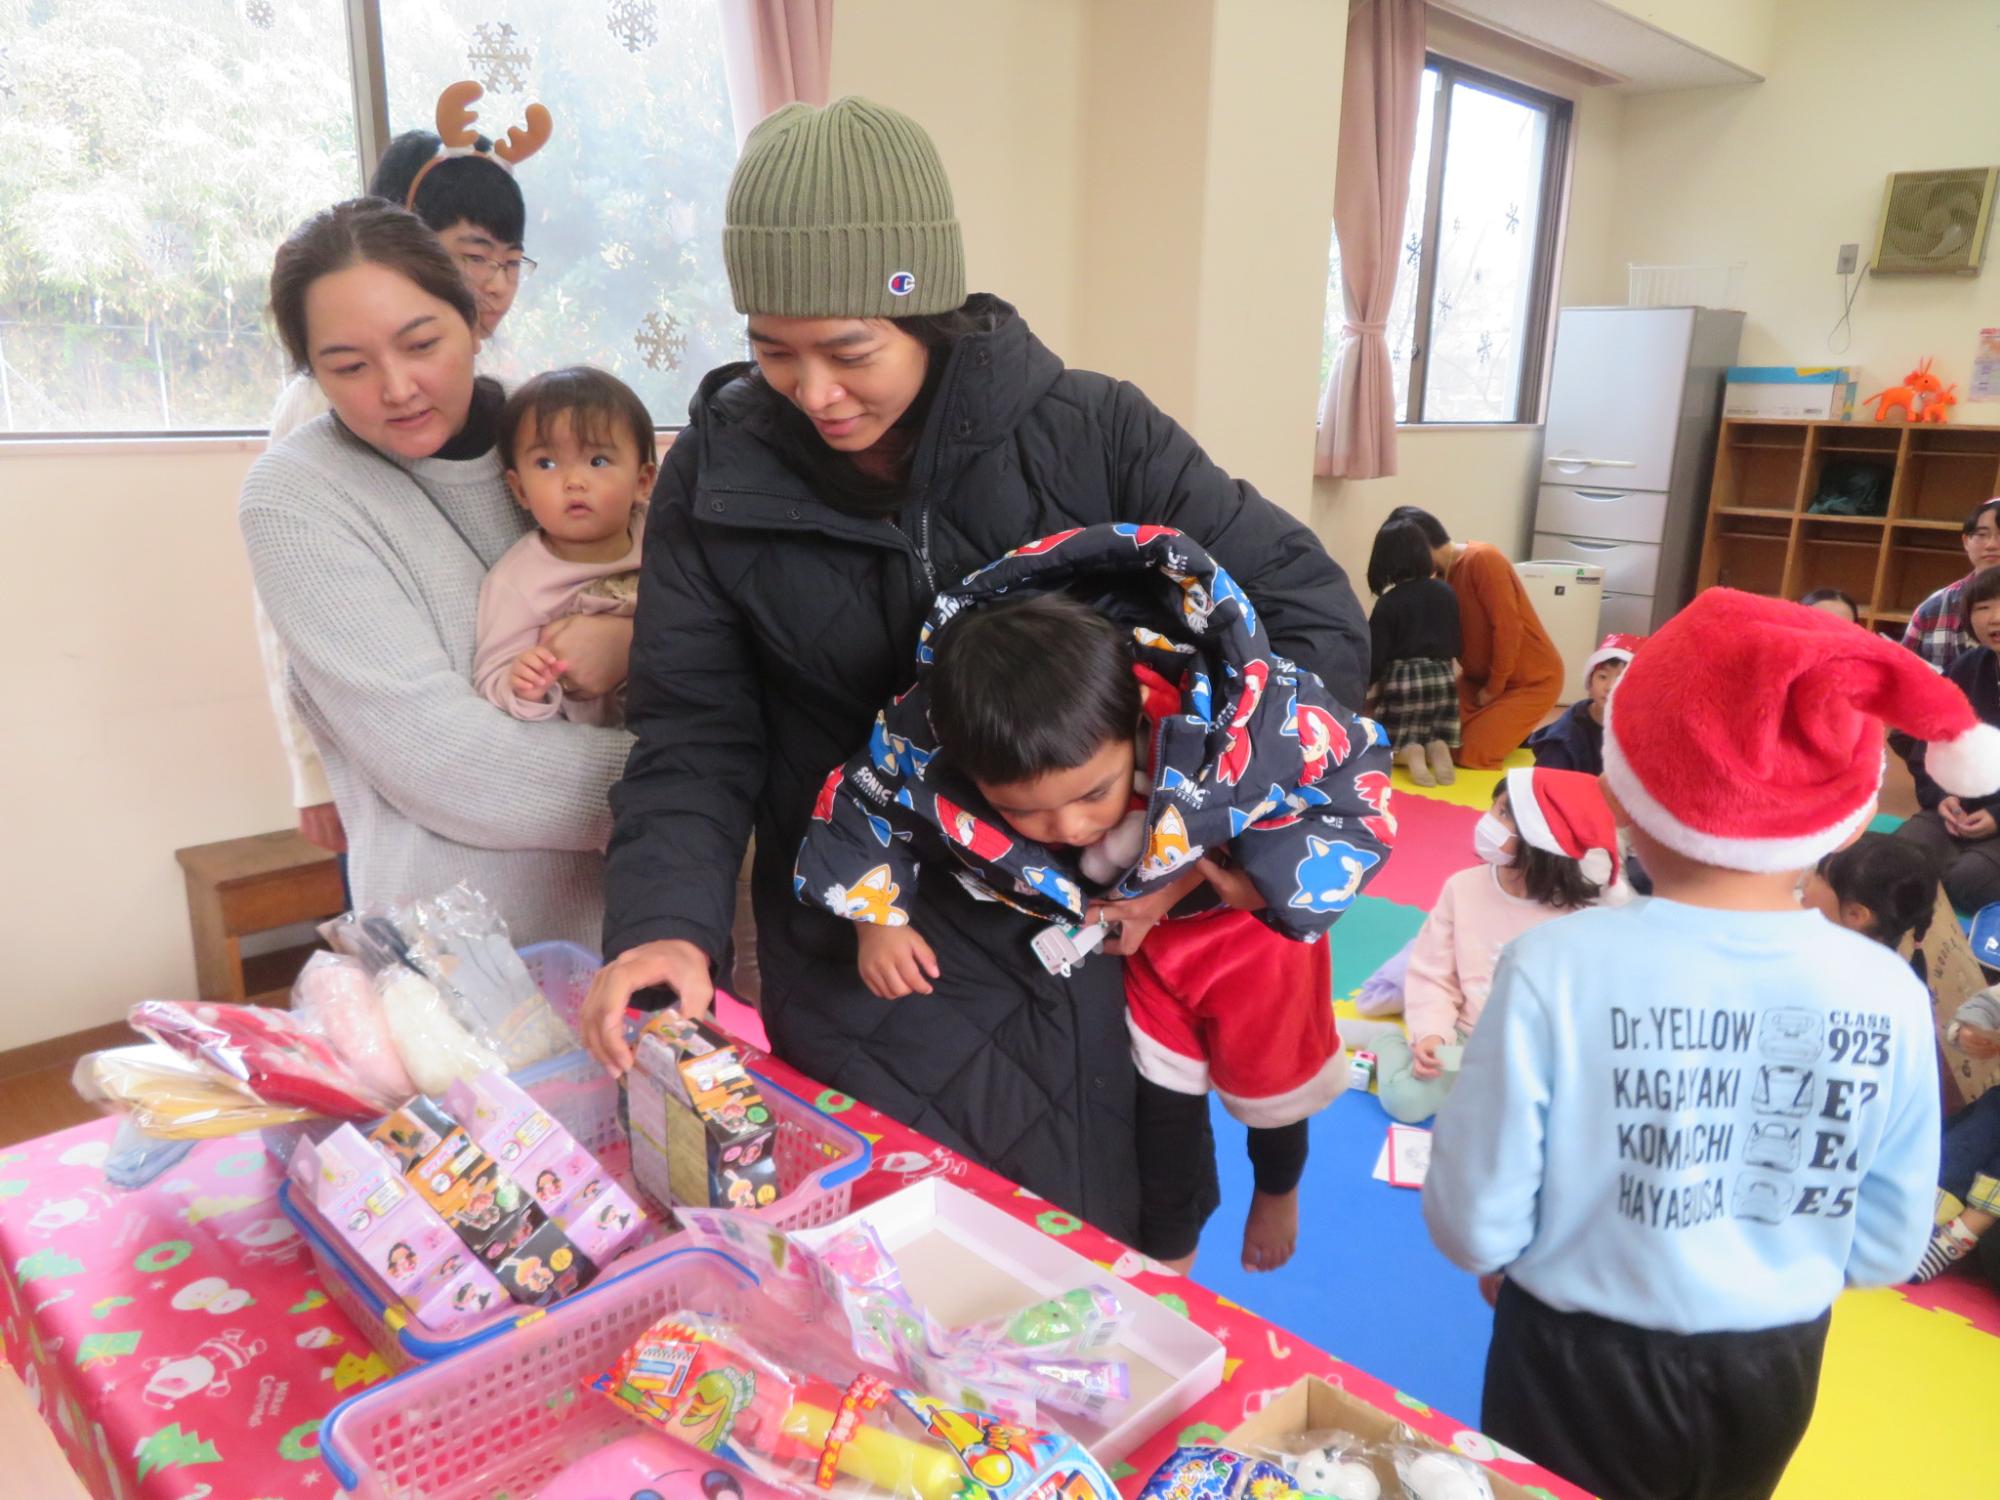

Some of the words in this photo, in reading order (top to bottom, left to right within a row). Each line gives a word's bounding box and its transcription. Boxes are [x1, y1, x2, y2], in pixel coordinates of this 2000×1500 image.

[857, 766, 893, 801] SONIC
[1610, 1006, 1756, 1052] Dr.YELLOW
[1829, 1009, 1891, 1030] CLASS
[1827, 1027, 1891, 1067] 923
[1613, 1067, 1741, 1112] KAGAYAKI
[1792, 1186, 1856, 1219] E5
